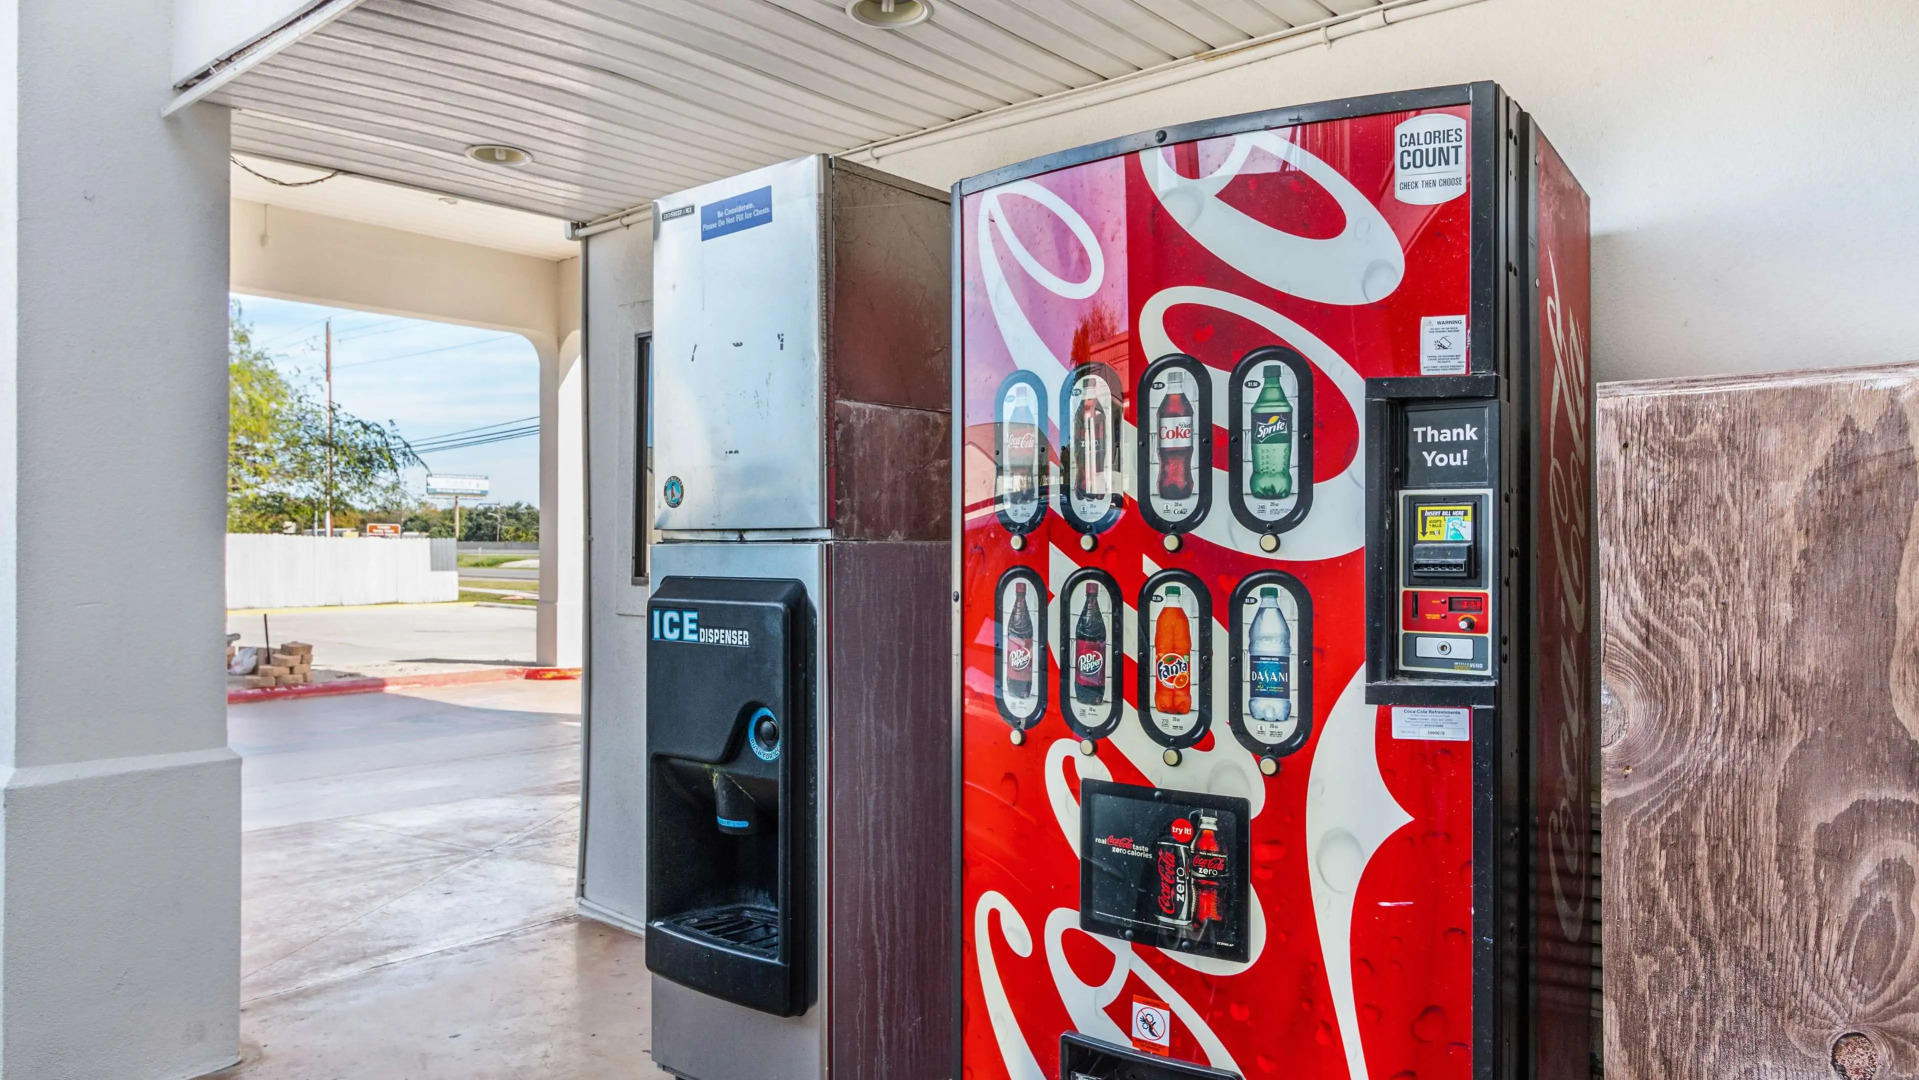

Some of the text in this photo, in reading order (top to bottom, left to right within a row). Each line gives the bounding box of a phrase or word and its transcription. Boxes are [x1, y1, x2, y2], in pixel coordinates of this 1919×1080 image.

[1399, 128, 1462, 147] CALORIES
[1400, 145, 1462, 170] COUNT
[1399, 177, 1463, 191] CHECK THEN CHOOSE
[726, 217, 735, 225] Not
[1159, 426, 1192, 440] Coke
[1258, 422, 1286, 438] Sprite
[1413, 423, 1478, 443] Thank
[1421, 450, 1468, 467] You!
[652, 610, 699, 642] ICE
[699, 628, 750, 646] DISPENSER
[1010, 651, 1030, 668] Pepper
[1016, 650, 1025, 658] Dr
[1086, 653, 1096, 662] Dr
[1078, 655, 1102, 672] Pepper
[1157, 660, 1188, 679] Fanta
[1251, 670, 1288, 683] DASANI
[1172, 826, 1183, 835] try
[1107, 835, 1134, 849] Coca-Cola
[1133, 844, 1149, 852] taste
[1127, 849, 1152, 859] calories
[1192, 855, 1224, 871] Coca-Cola
[1198, 868, 1218, 876] zero
[1158, 848, 1176, 914] Coca-Cola
[1176, 867, 1185, 902] zero
